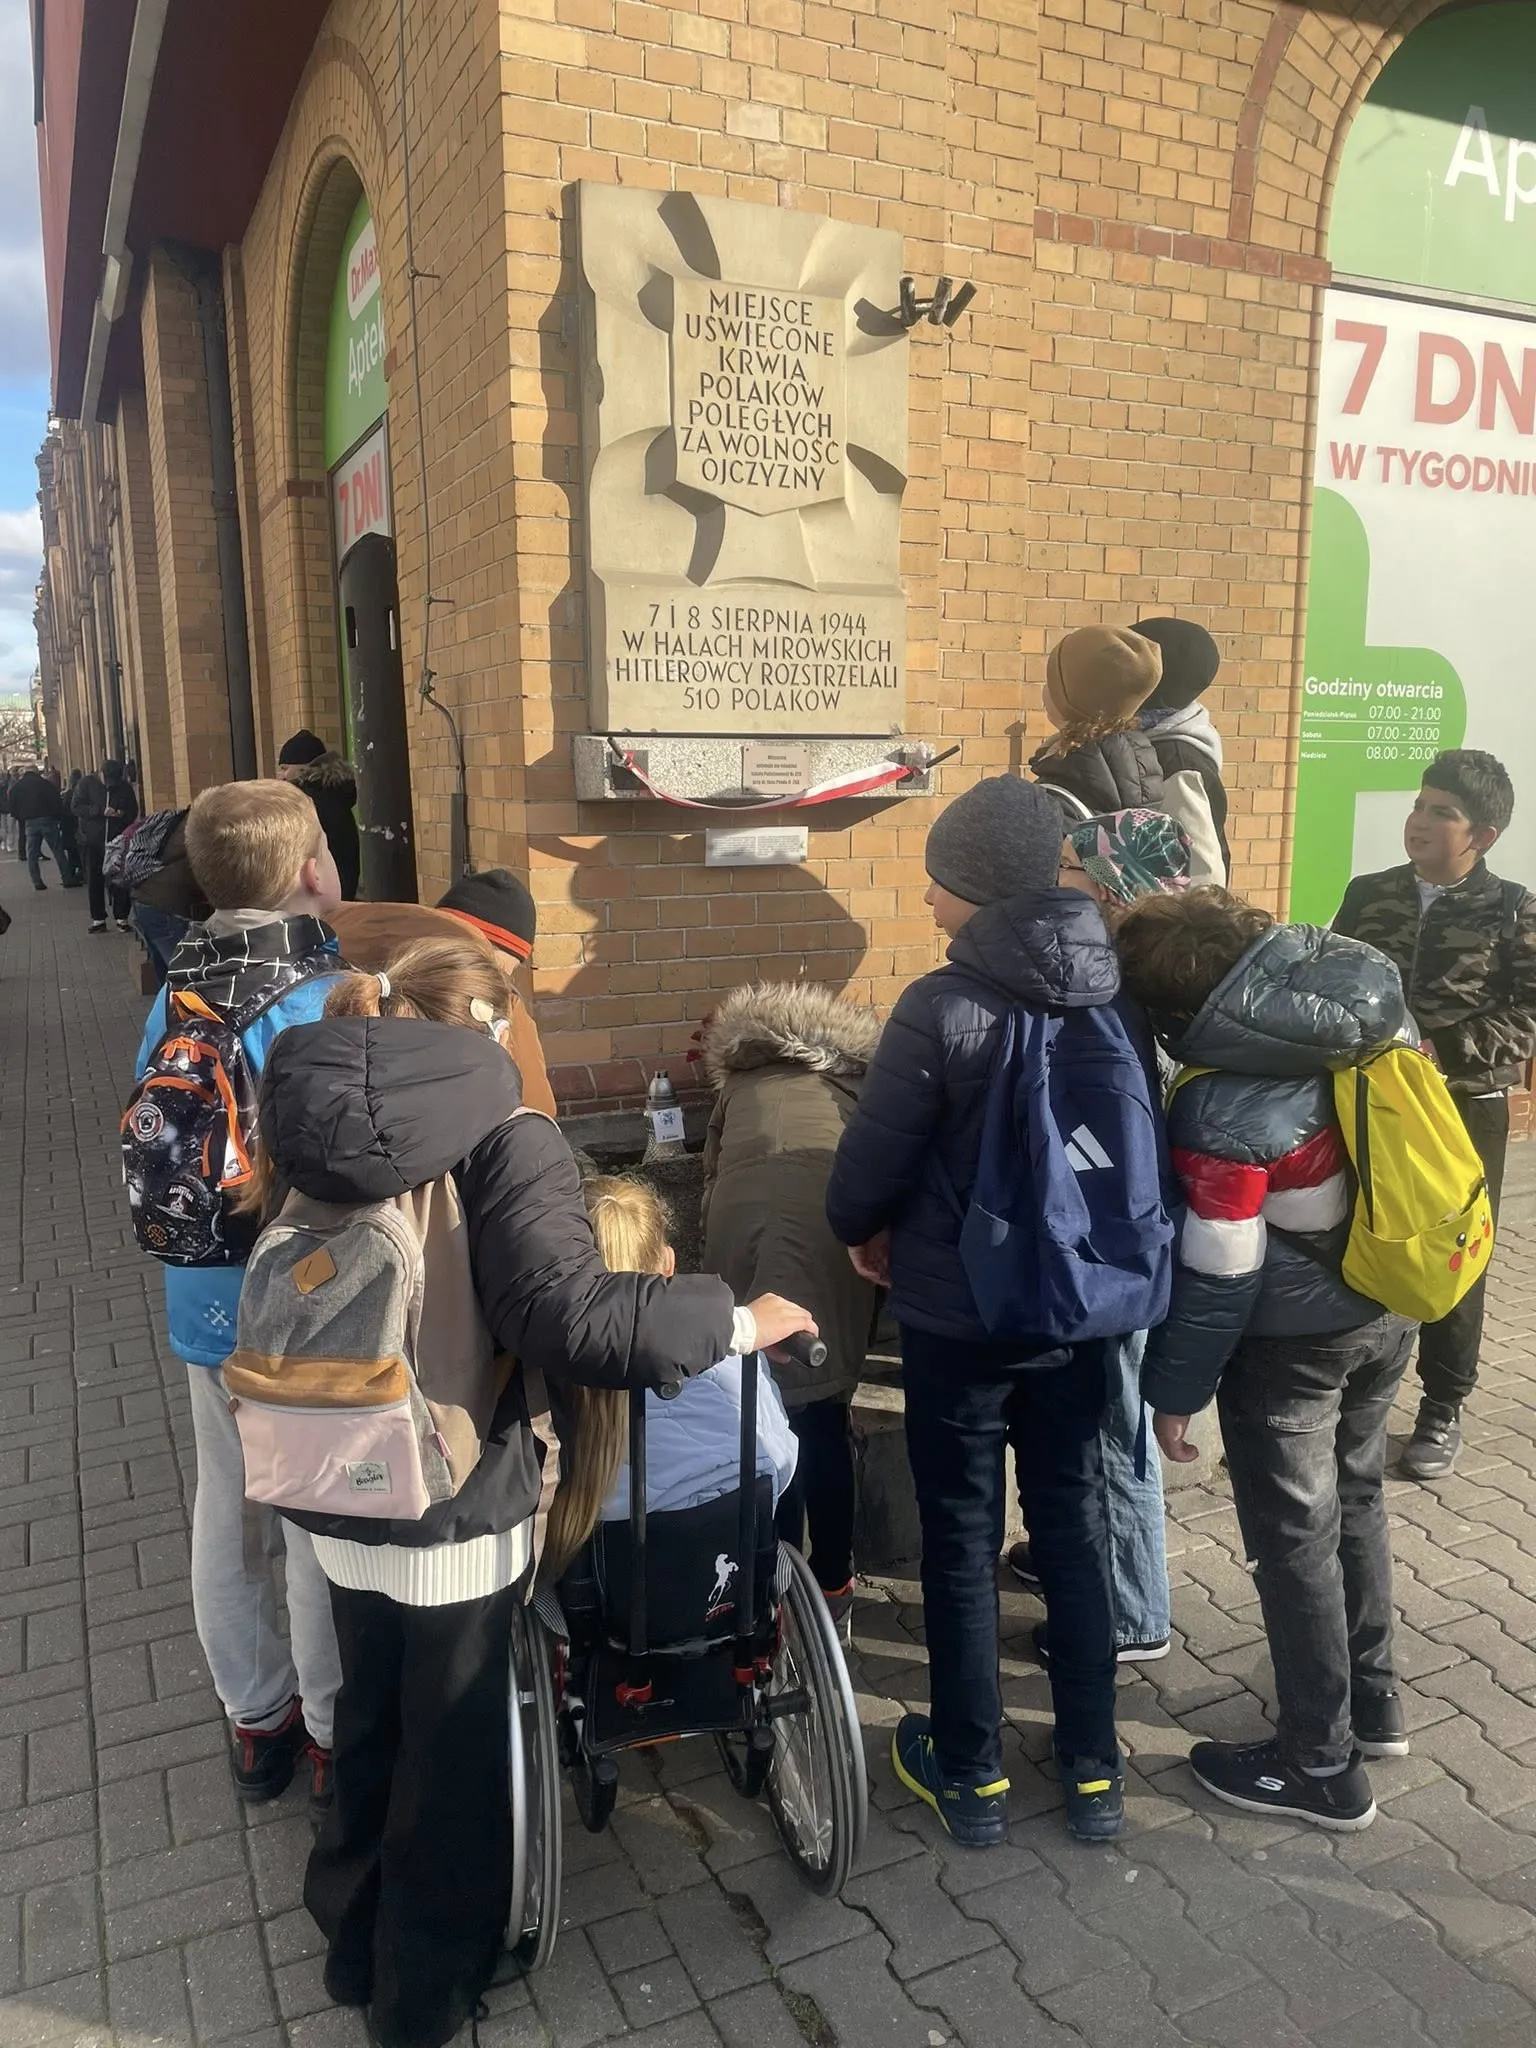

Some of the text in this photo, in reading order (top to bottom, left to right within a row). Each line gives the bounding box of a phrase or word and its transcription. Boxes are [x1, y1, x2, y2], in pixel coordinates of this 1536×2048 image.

[709, 288, 813, 327] MIEJSCE
[1335, 318, 1388, 416] 7
[688, 399, 832, 438] POLEGŁYCH
[680, 426, 713, 455] ZA
[701, 457, 826, 491] OJCZYZNY
[1329, 441, 1367, 482] W
[339, 450, 384, 546] 7 DNI
[649, 604, 660, 627] 7
[687, 605, 700, 630] 8
[711, 606, 814, 635] SIERPNIA
[820, 612, 867, 636] 1944
[622, 630, 891, 663] W HALACH MIROWSKICH
[615, 657, 898, 689] HITLEROWCY ROZSTRZELALI
[1304, 675, 1444, 701] Godziny otwarcia
[682, 686, 720, 710] 510
[1368, 705, 1401, 720] 07.00
[1410, 706, 1442, 721] 21.00
[1367, 726, 1400, 740] 07.00
[1408, 726, 1440, 741] 20.00
[1366, 746, 1398, 760] 08.00
